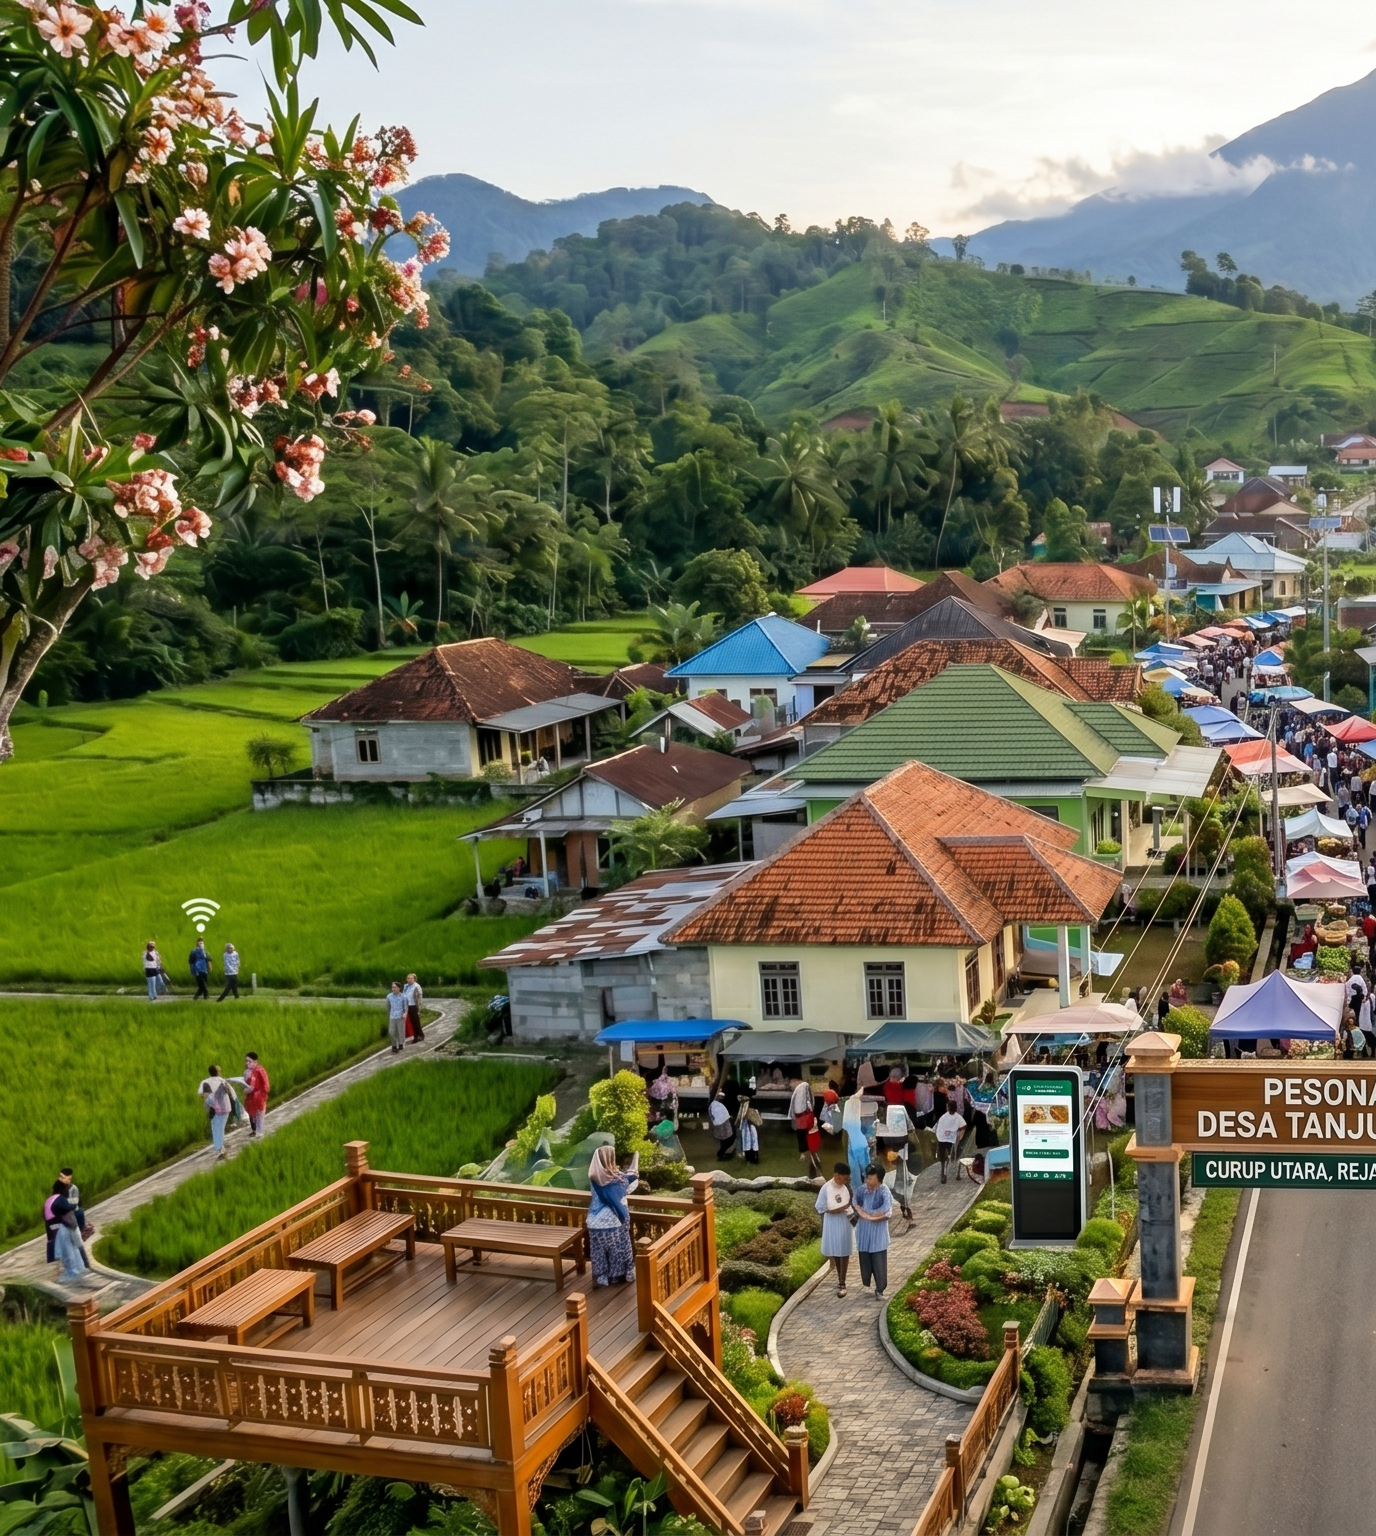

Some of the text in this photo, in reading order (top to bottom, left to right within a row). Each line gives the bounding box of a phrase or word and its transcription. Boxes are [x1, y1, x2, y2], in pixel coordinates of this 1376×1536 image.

[1198, 1111, 1277, 1138] DESA
[1206, 1161, 1265, 1178] CURUP
[1271, 1162, 1332, 1181] UTARA,
